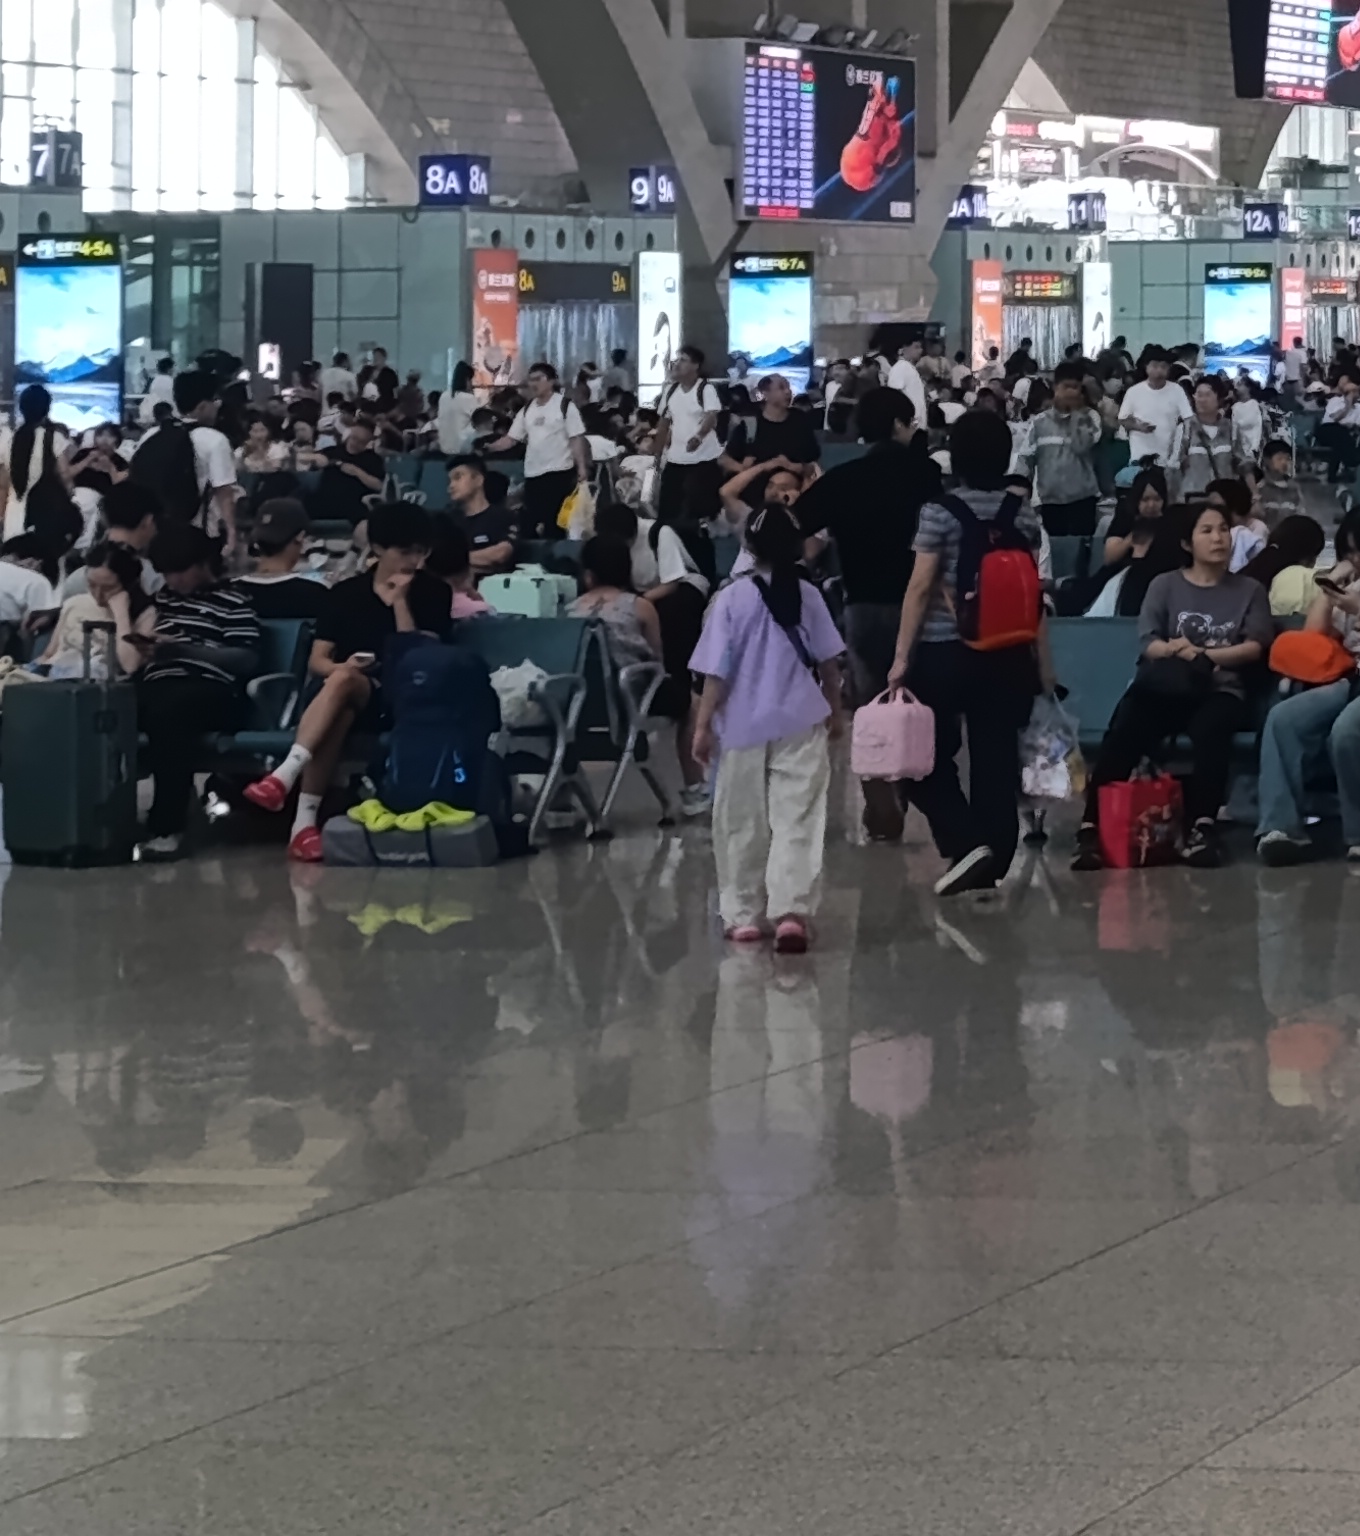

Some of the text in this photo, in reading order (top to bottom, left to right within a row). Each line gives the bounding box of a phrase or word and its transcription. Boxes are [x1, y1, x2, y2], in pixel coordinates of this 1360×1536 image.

[58, 143, 82, 176] 7A
[426, 165, 461, 195] 8A
[469, 165, 488, 195] 8A
[658, 175, 675, 203] 9A
[1244, 209, 1272, 233] 12A
[519, 268, 535, 292] 8A
[612, 271, 626, 292] 9A
